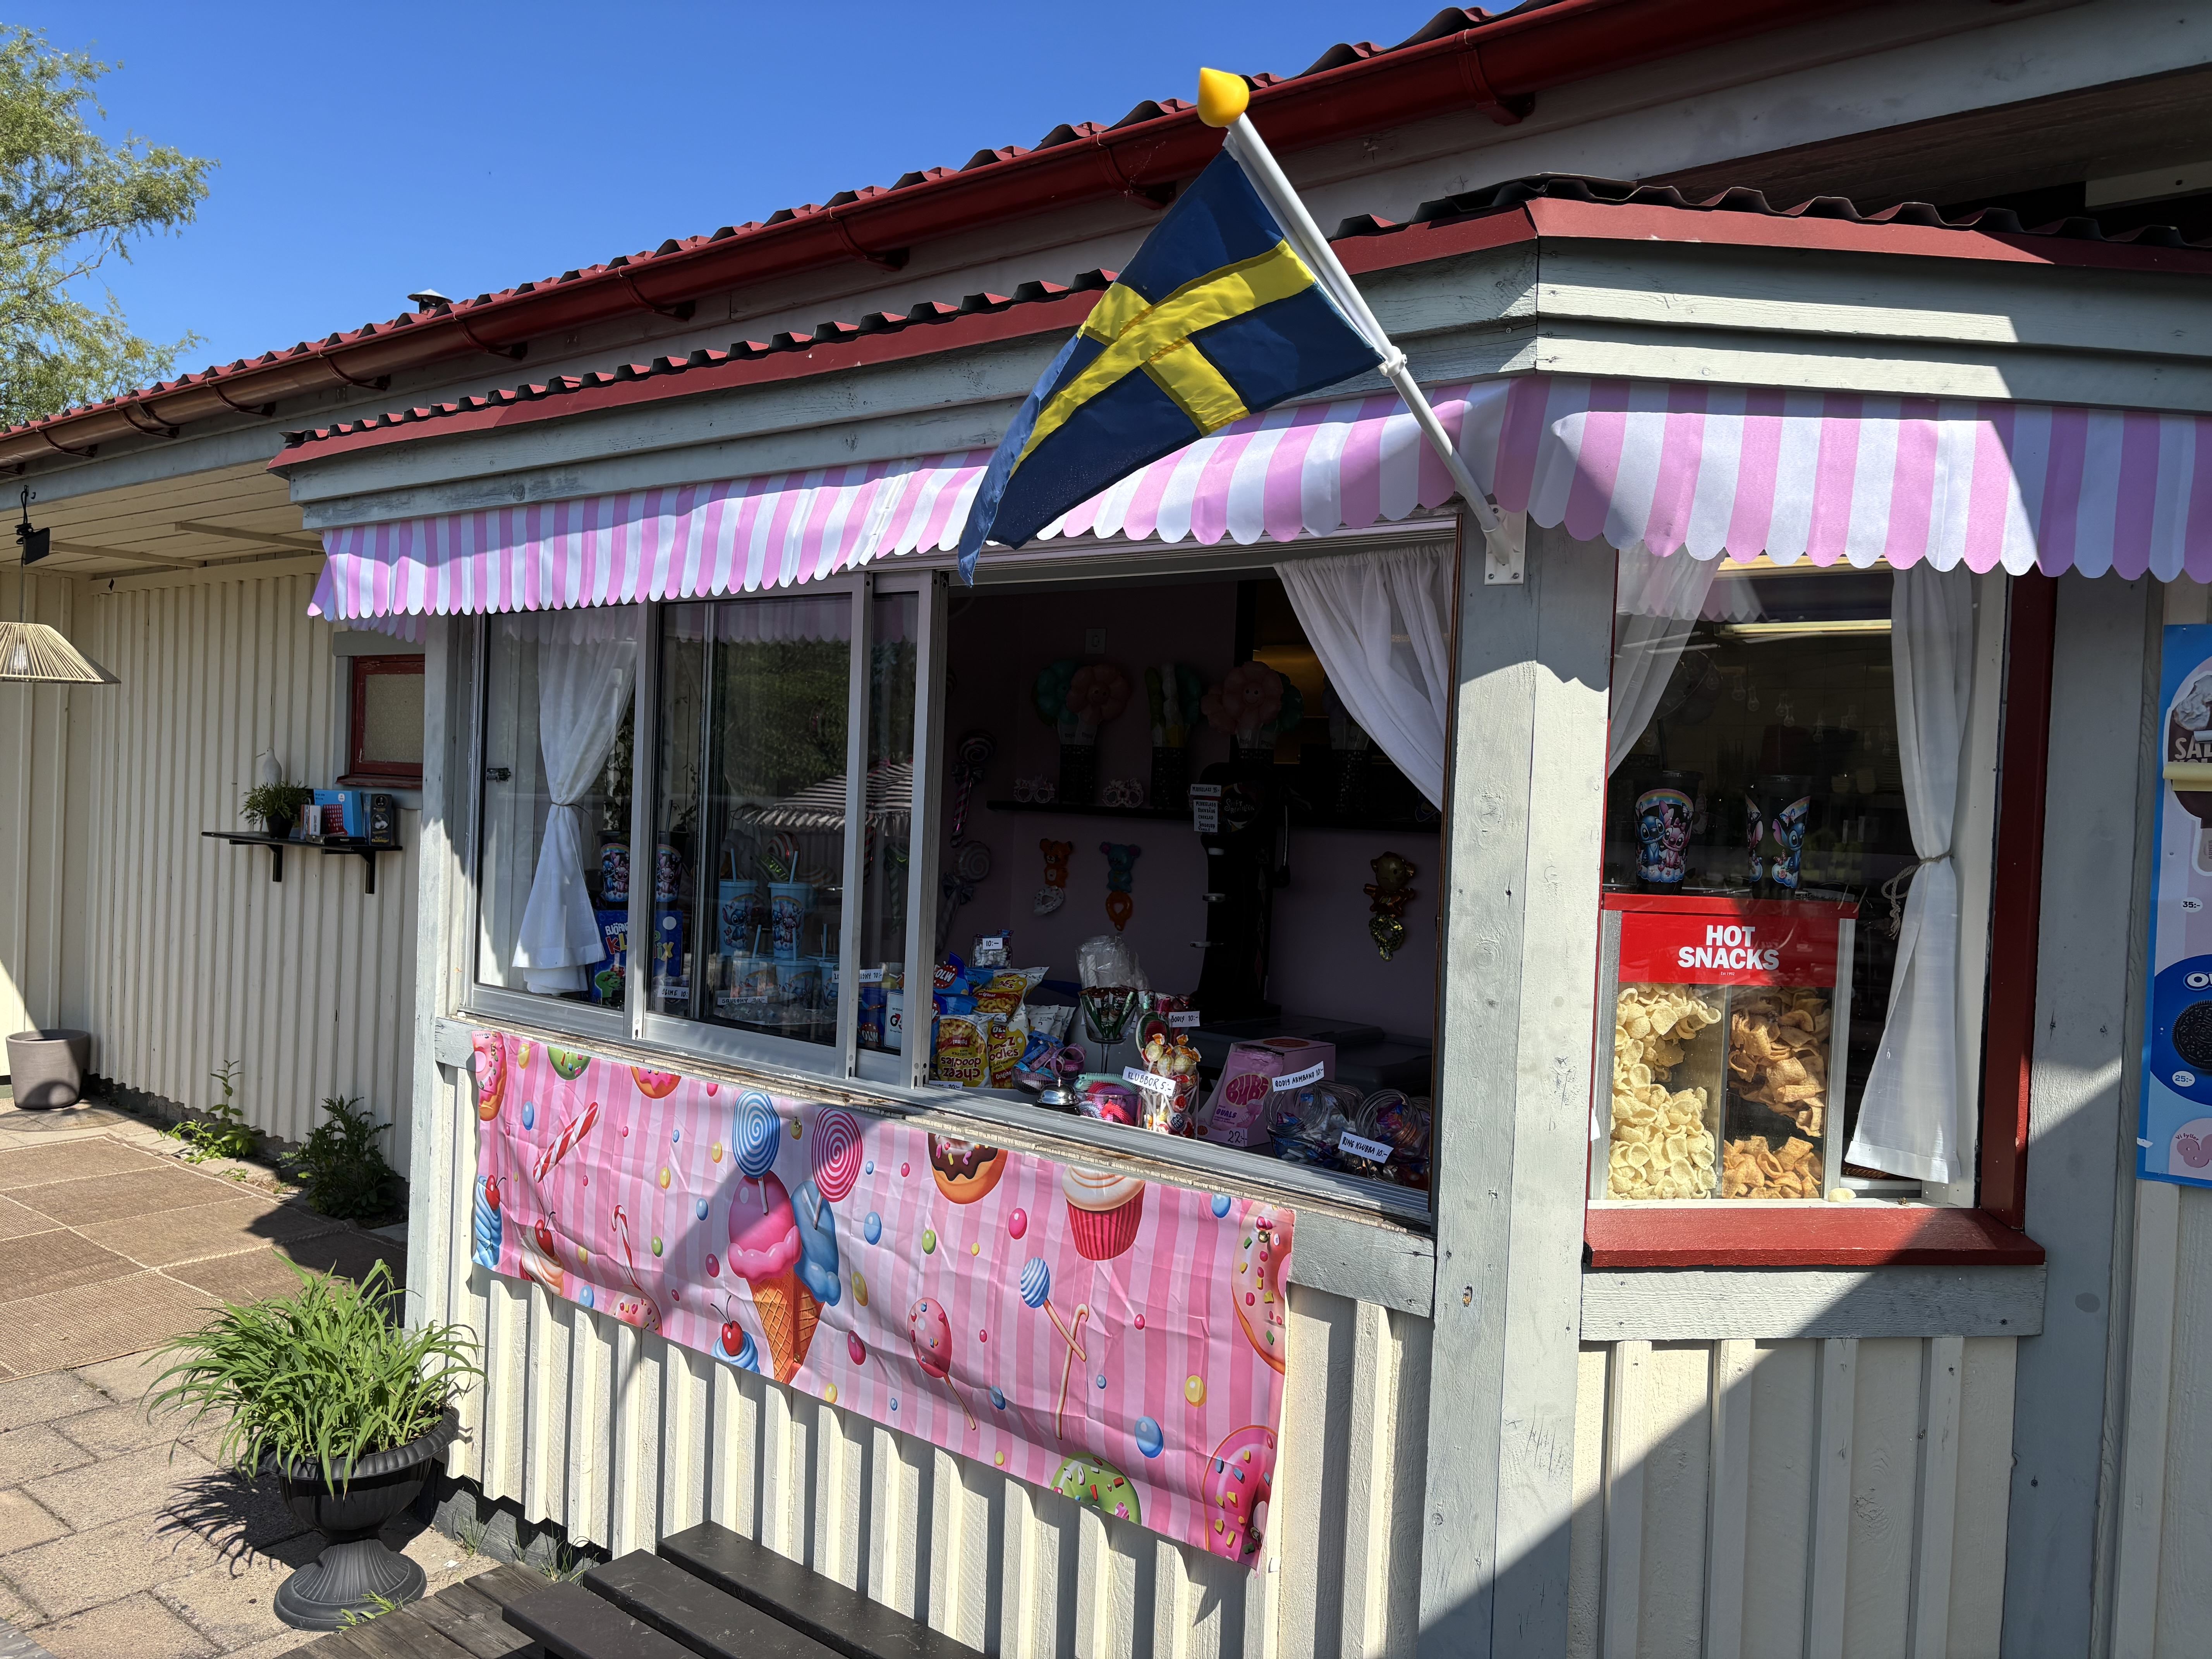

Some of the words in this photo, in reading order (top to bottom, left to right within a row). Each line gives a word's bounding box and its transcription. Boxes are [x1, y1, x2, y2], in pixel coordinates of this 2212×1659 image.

[1705, 925, 1755, 947] HOT
[1677, 946, 1779, 970] SNACKS
[935, 969, 956, 983] OLW
[2187, 973, 2212, 987] O
[861, 1029, 879, 1043] OLW
[941, 1057, 982, 1068] doodles
[943, 1067, 981, 1081] cheez
[996, 1070, 1012, 1080] Origina
[1128, 1071, 1159, 1089] KLUBBOR
[1160, 1082, 1171, 1091] 5:-
[1292, 1072, 1314, 1084] ARMBAND
[2174, 1075, 2193, 1083] 25:-
[1225, 1074, 1269, 1106] BUBS
[1216, 1108, 1237, 1118] OVALS
[2183, 1133, 2199, 1141] fyller
[1342, 1136, 1355, 1148] RING
[1355, 1142, 1375, 1154] KLUBBA
